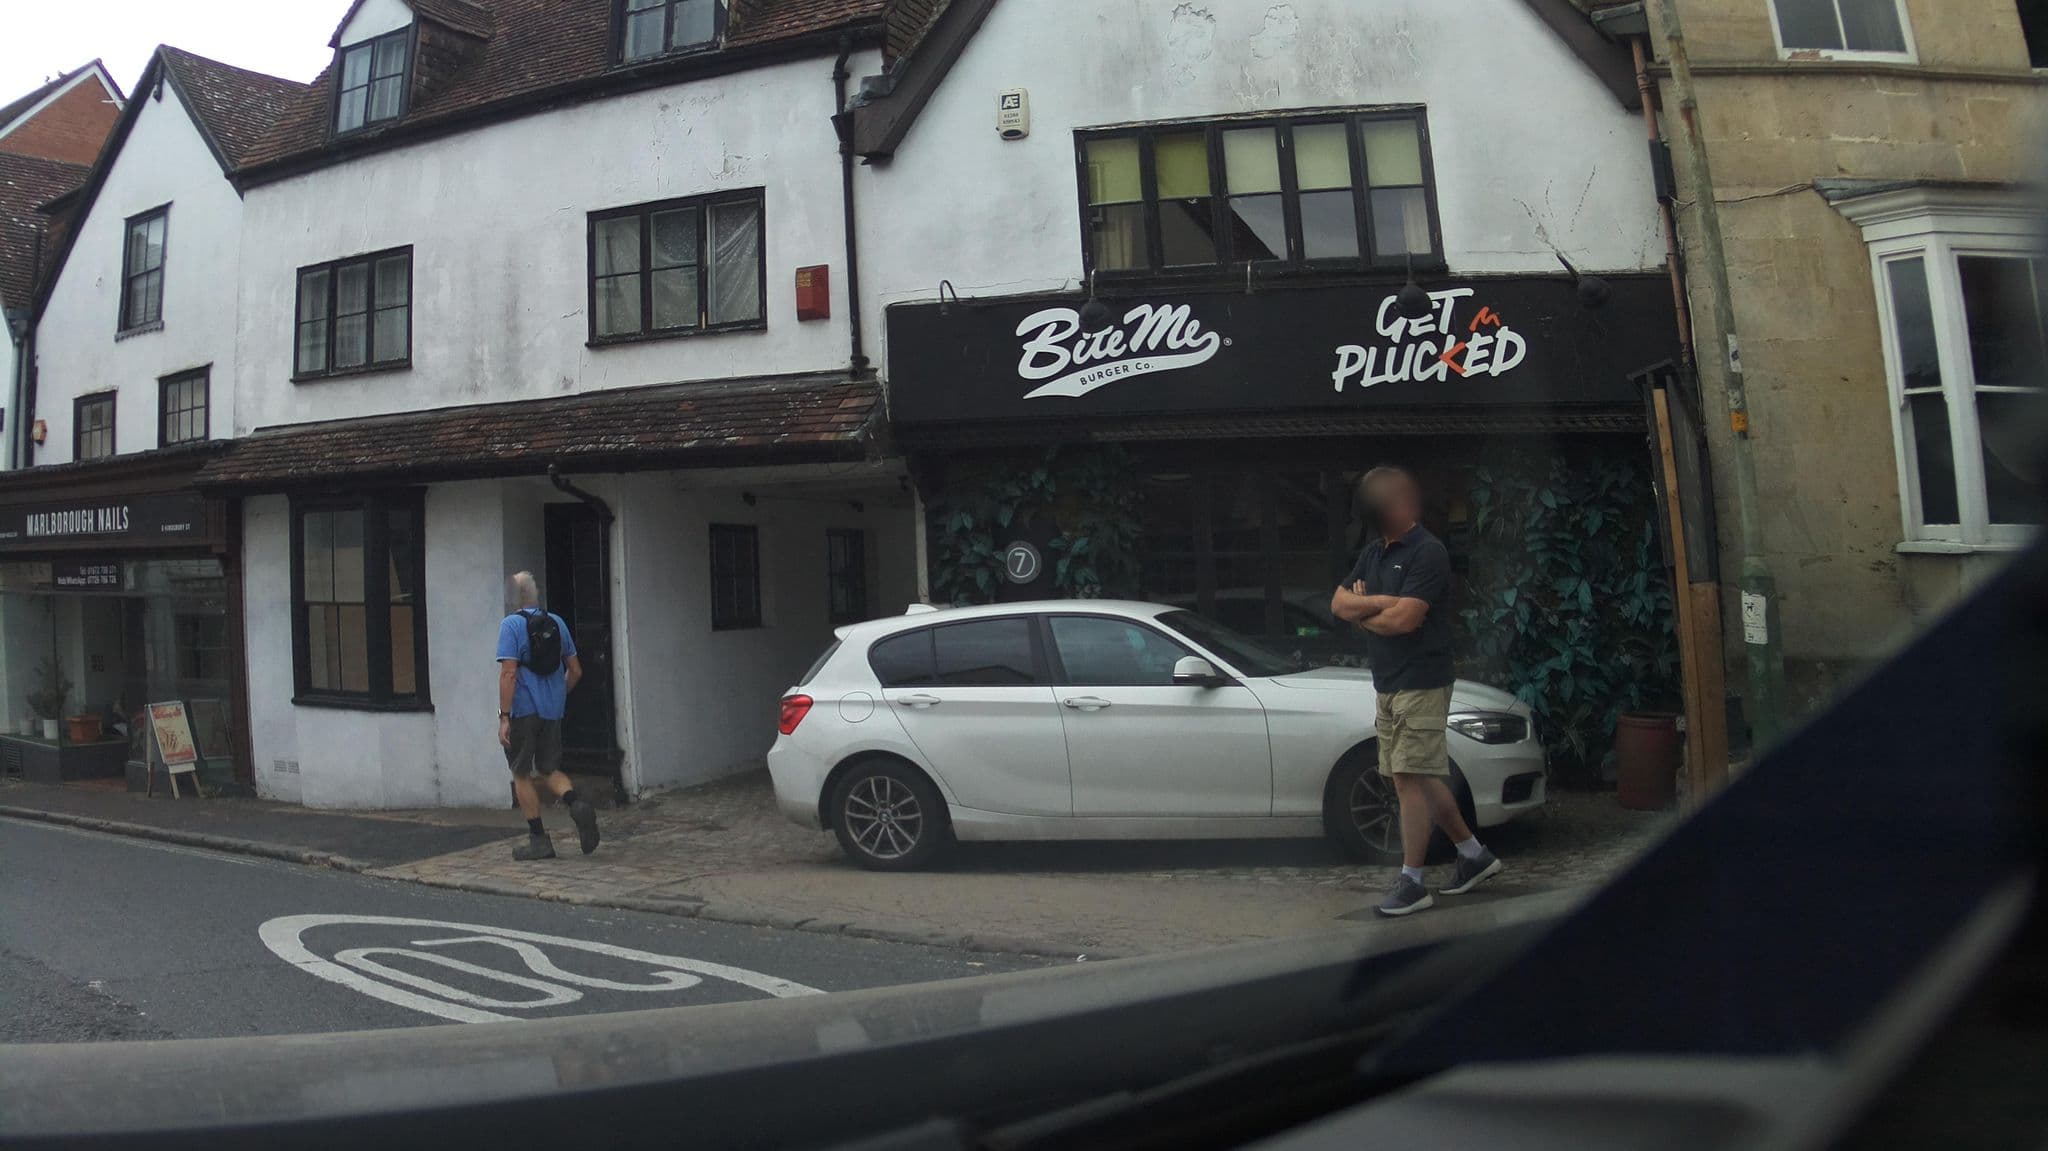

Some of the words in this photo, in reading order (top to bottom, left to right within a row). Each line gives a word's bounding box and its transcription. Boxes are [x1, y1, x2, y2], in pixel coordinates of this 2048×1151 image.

[1376, 287, 1474, 343] GET
[1015, 307, 1127, 380] Bite
[1123, 303, 1221, 356] Me
[1331, 325, 1527, 393] PLUCKED
[1079, 364, 1130, 386] BURGER
[1135, 360, 1155, 372] Co.
[27, 509, 94, 537] MARLBOROUGH
[98, 505, 129, 532] NAILS
[1014, 552, 1026, 573] 7
